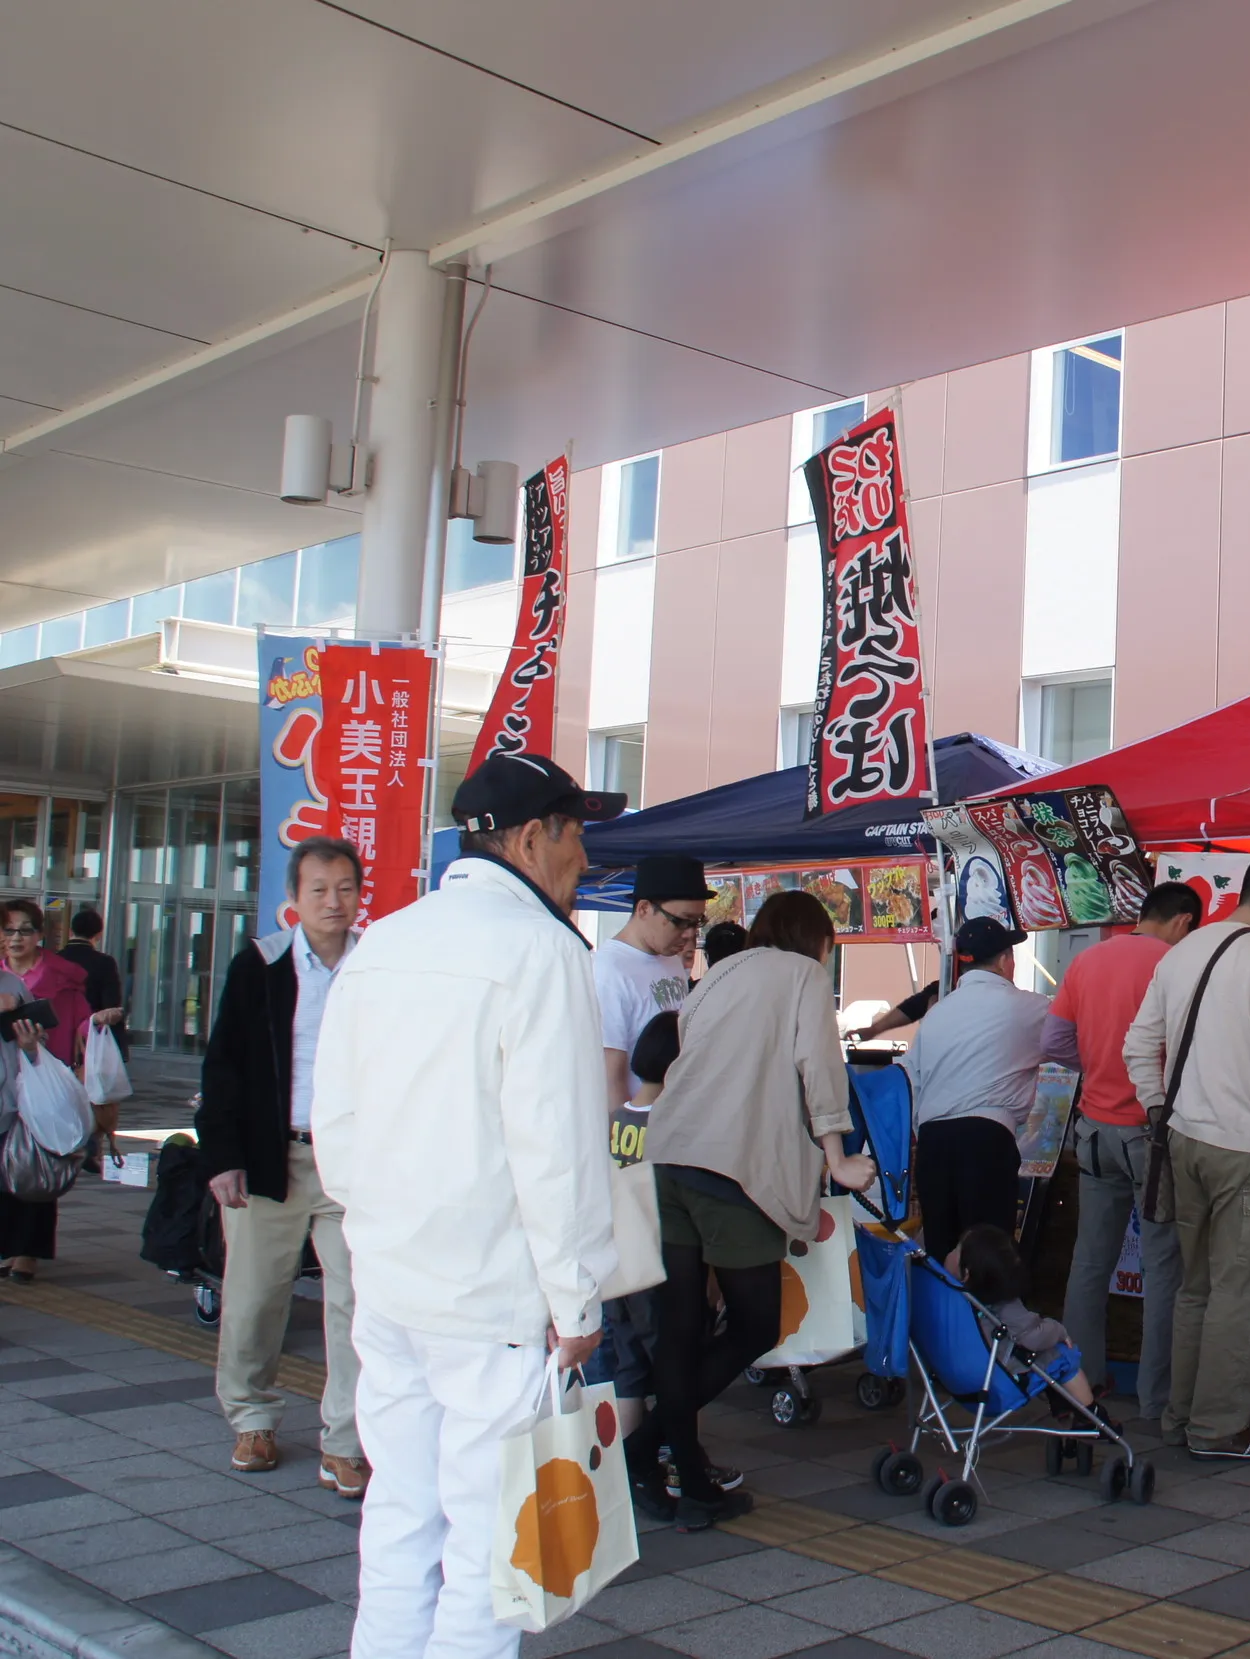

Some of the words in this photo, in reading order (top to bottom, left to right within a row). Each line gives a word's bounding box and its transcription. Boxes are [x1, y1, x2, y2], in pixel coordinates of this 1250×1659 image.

[387, 678, 410, 788] 一般社団法人
[864, 823, 909, 837] CAPTAIN
[909, 821, 930, 835] STA
[1031, 801, 1075, 848] 抹茶
